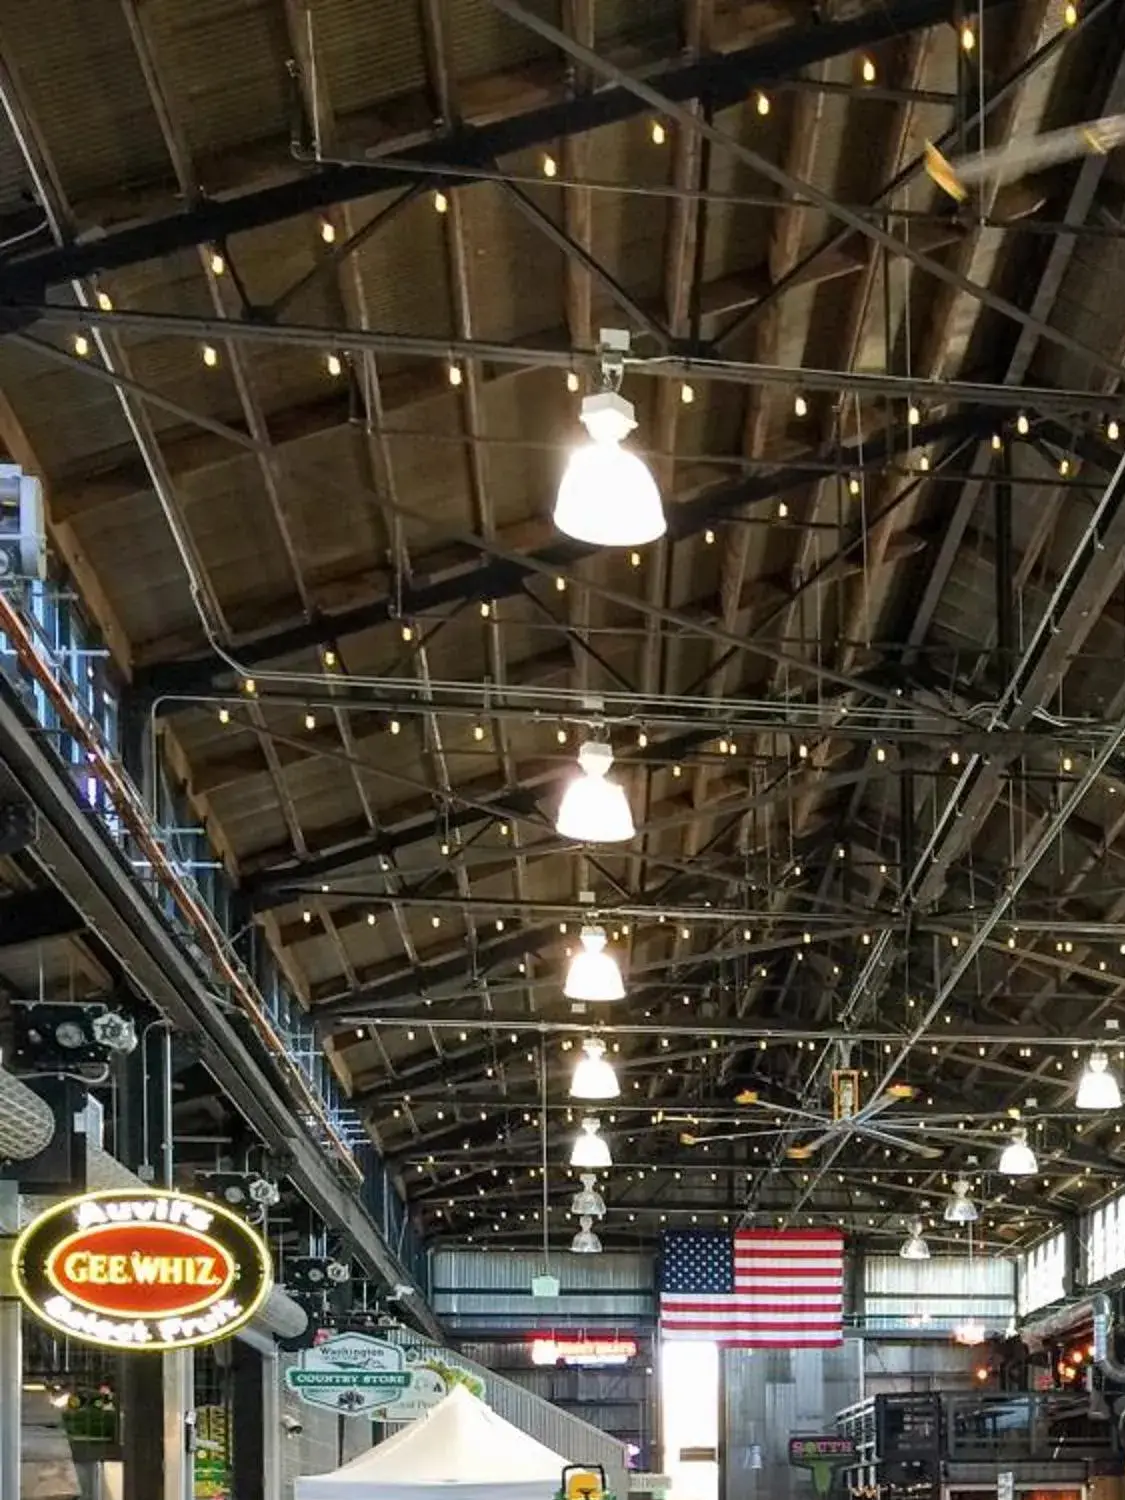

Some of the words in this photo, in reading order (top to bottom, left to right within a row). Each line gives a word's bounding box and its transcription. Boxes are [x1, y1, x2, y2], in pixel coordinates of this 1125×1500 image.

[64, 1251, 128, 1284] GEE
[296, 1373, 358, 1385] COUNTRY
[362, 1373, 406, 1385] STORE
